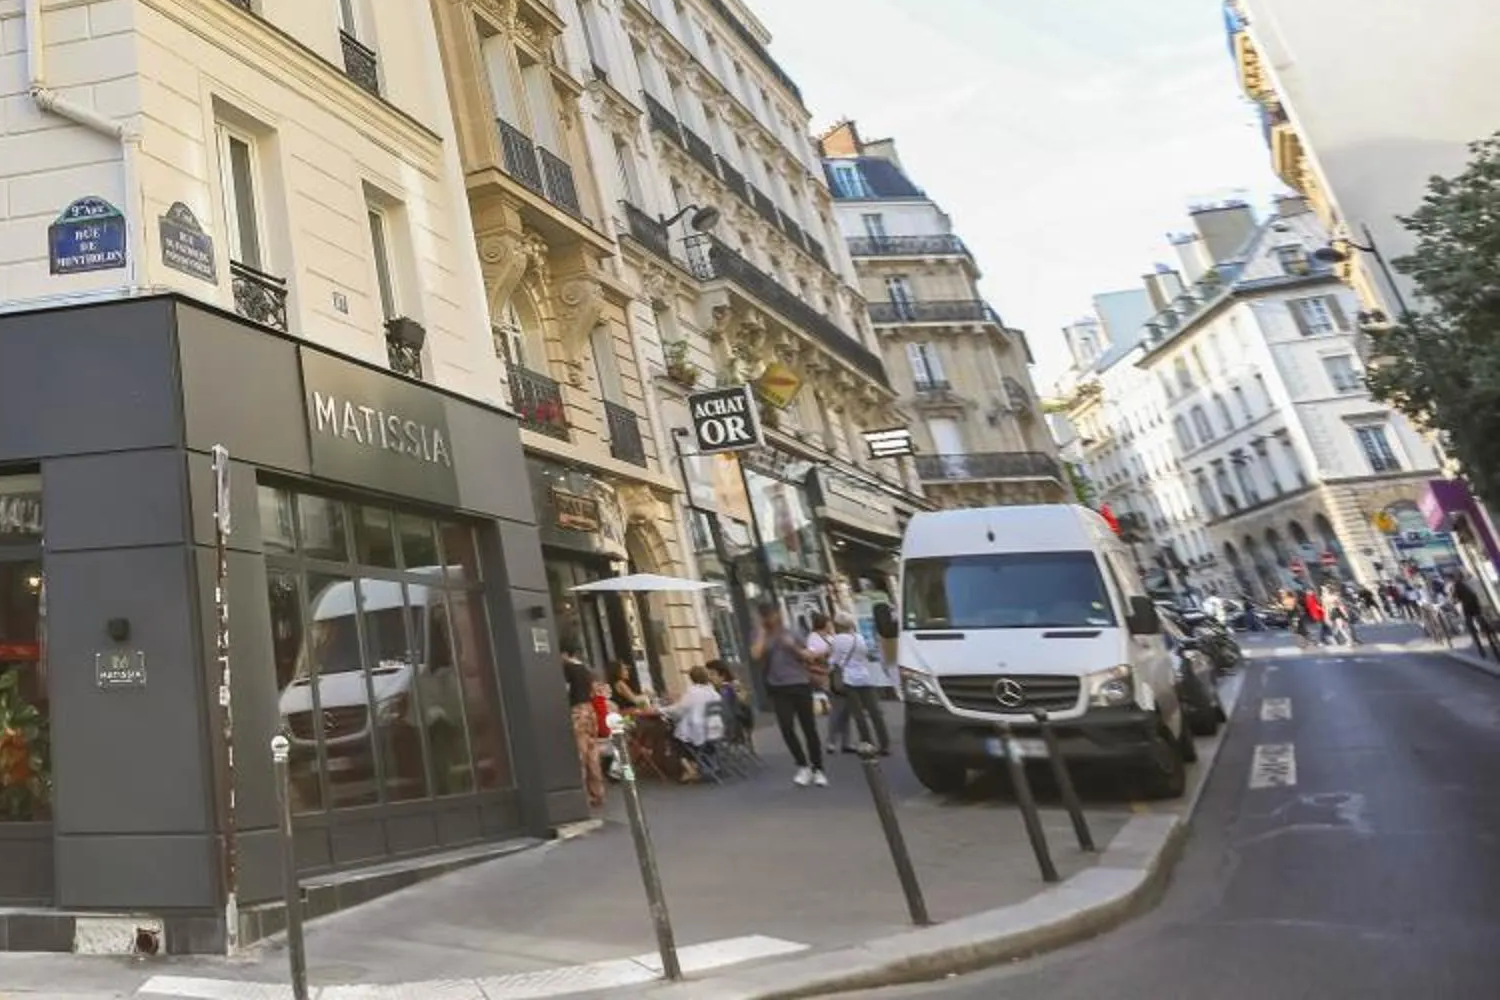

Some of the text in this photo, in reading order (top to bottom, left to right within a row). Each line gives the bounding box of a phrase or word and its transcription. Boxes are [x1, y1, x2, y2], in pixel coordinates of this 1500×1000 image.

[75, 227, 100, 241] RUE
[694, 395, 746, 419] ACHAT
[313, 391, 451, 468] MATISSIA
[700, 415, 751, 446] OR
